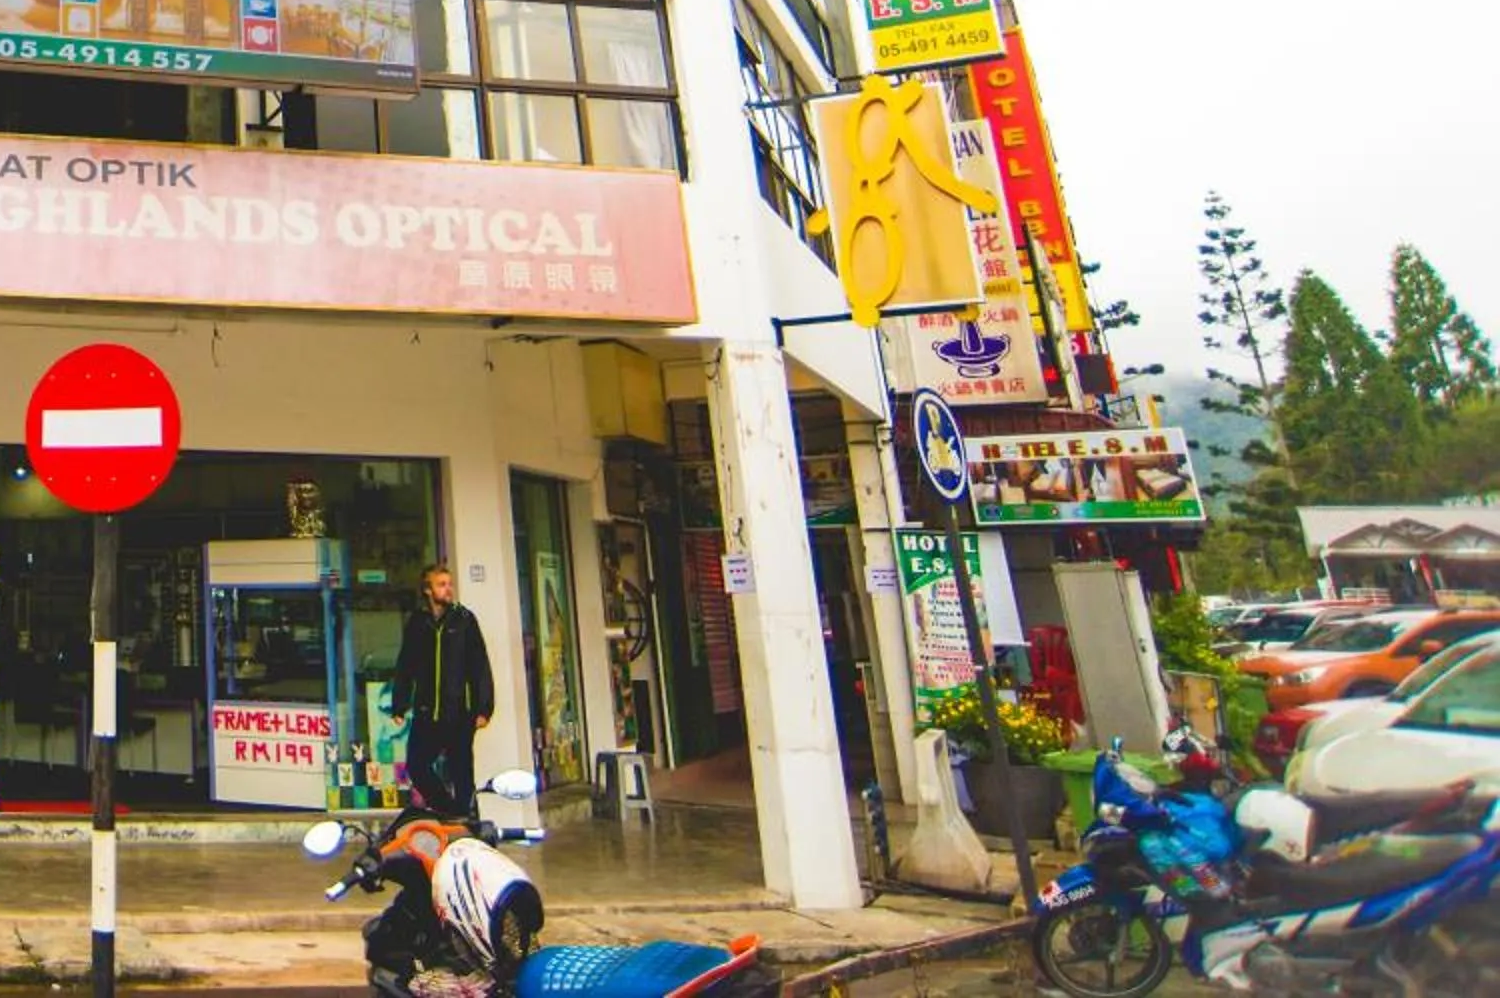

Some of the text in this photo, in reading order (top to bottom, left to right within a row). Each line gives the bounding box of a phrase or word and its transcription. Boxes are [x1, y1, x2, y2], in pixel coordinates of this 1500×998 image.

[65, 156, 197, 189] OPTIK
[336, 201, 614, 257] OPTICAL
[902, 533, 978, 553] HOTL
